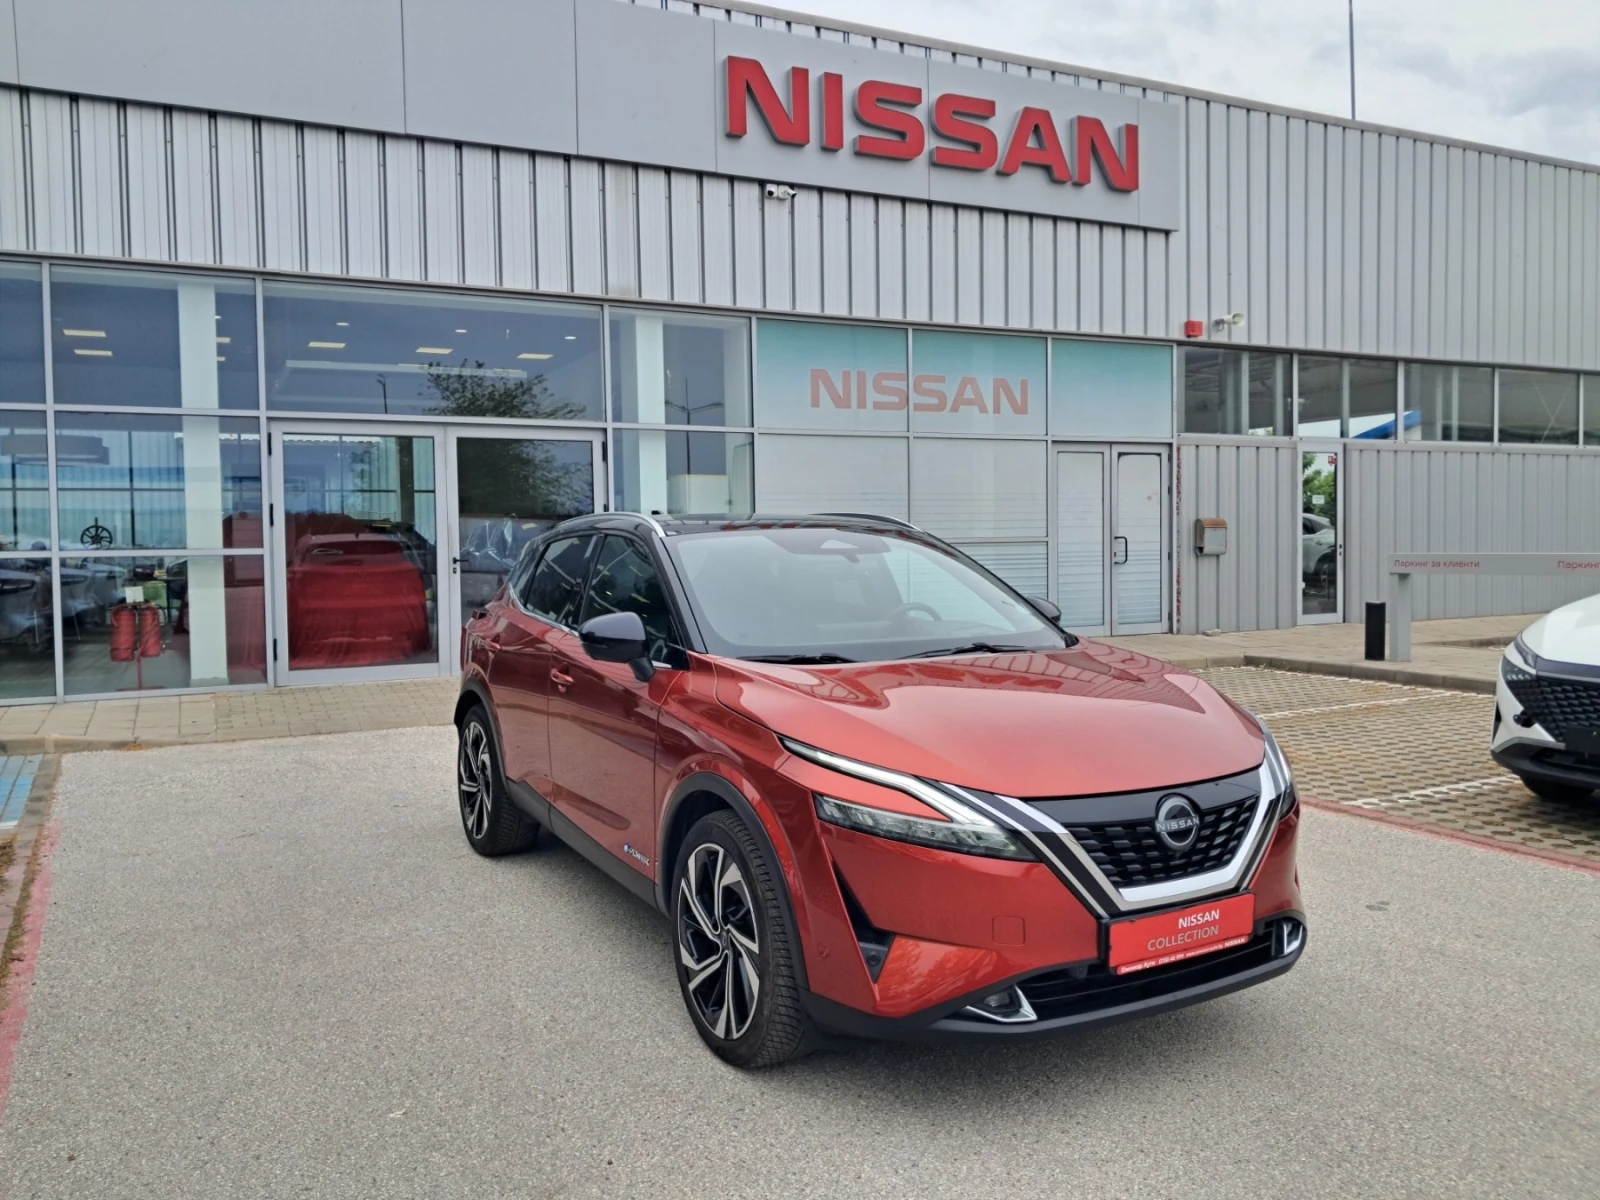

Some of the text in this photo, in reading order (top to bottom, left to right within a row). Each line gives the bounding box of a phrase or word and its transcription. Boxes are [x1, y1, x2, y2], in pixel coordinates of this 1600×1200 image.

[725, 55, 1139, 192] NISSAN
[810, 368, 1028, 415] NISSAN
[1394, 560, 1428, 569] Паркинг
[1156, 815, 1199, 832] NISSAN
[1178, 909, 1220, 929] NISSAN
[1147, 925, 1219, 951] COLLECTION
